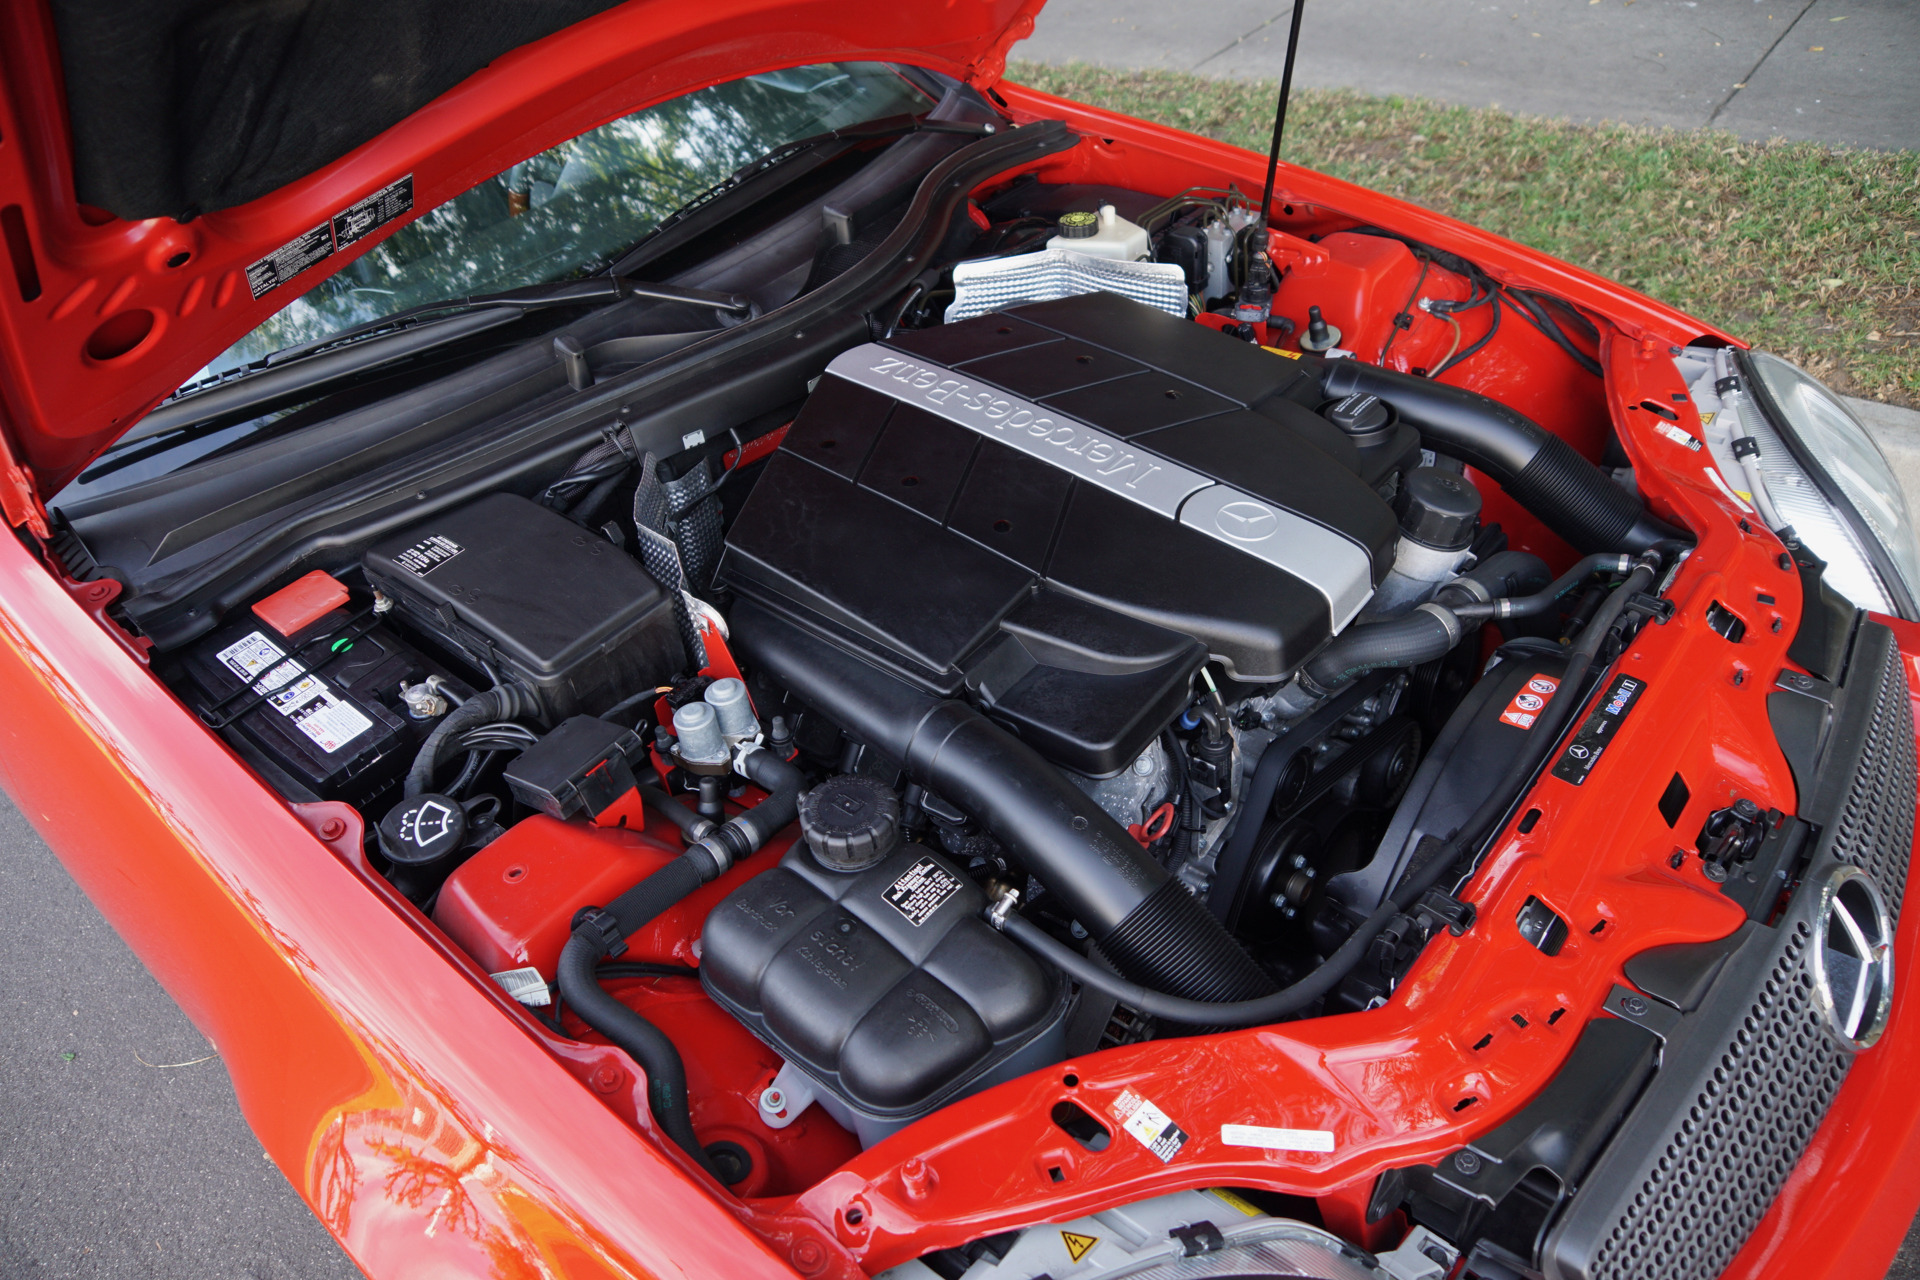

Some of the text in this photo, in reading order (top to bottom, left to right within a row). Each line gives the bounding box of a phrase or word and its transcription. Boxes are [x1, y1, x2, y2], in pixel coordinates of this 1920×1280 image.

[252, 276, 278, 293] CATALYST
[869, 357, 1161, 489] Mercedes-Benz
[1605, 687, 1631, 716] Mobil
[893, 863, 923, 890] Attention!
